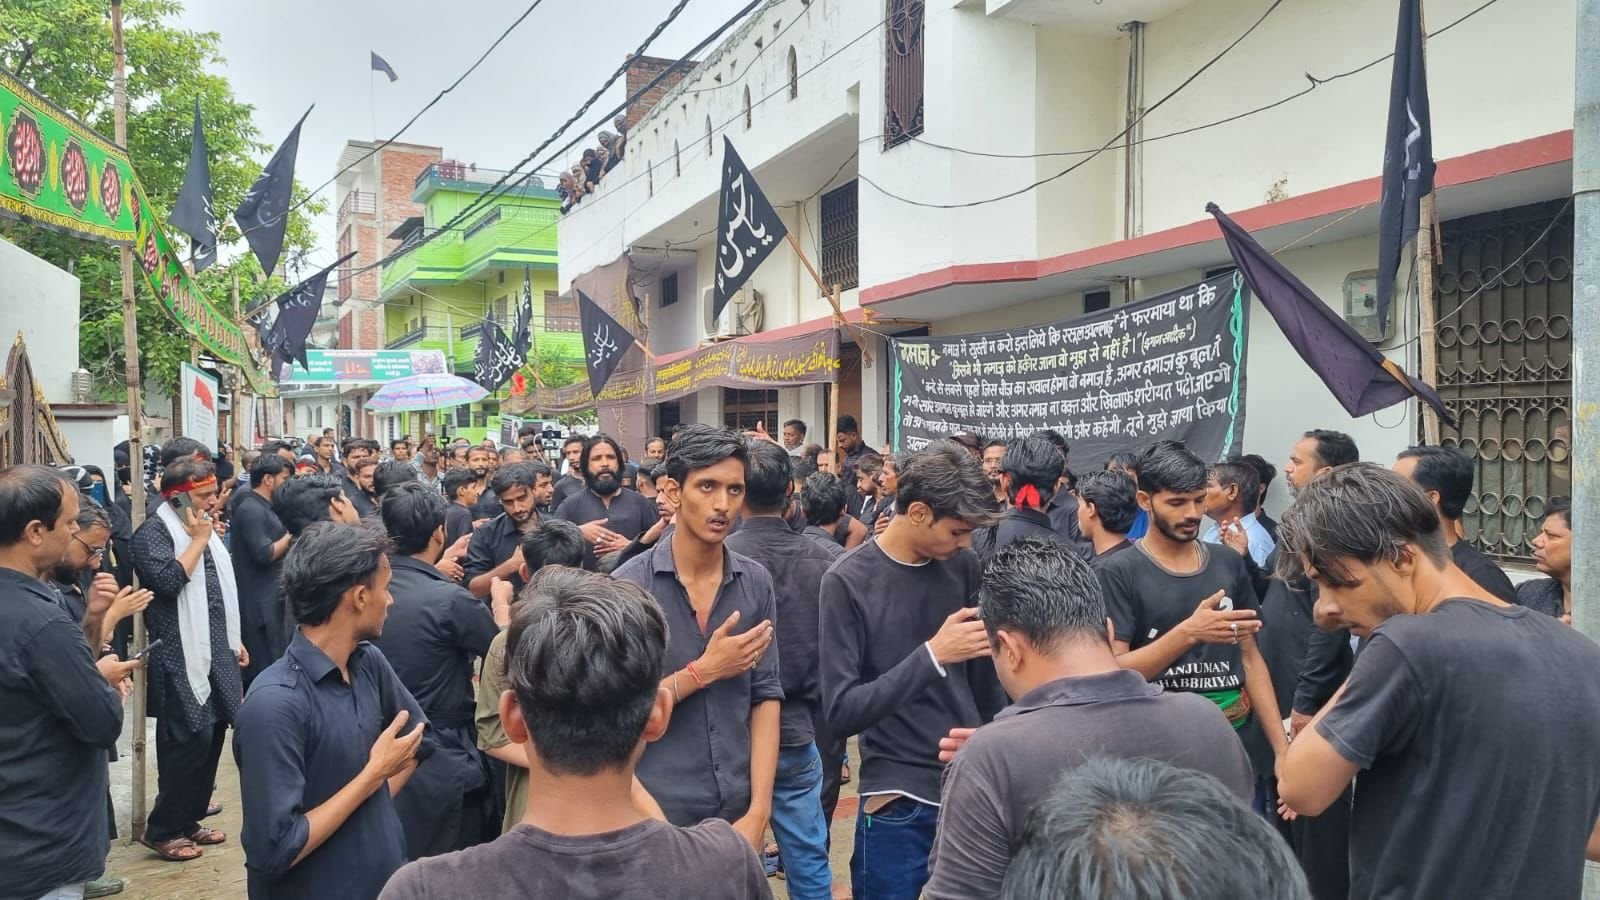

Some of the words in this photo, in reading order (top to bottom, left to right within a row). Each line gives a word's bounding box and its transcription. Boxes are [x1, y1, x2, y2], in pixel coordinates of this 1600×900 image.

[1179, 294, 1194, 311] था
[1197, 283, 1217, 308] कि
[1164, 661, 1230, 676] ANJUMAN
[1157, 675, 1240, 689] HABBIRIYAH
